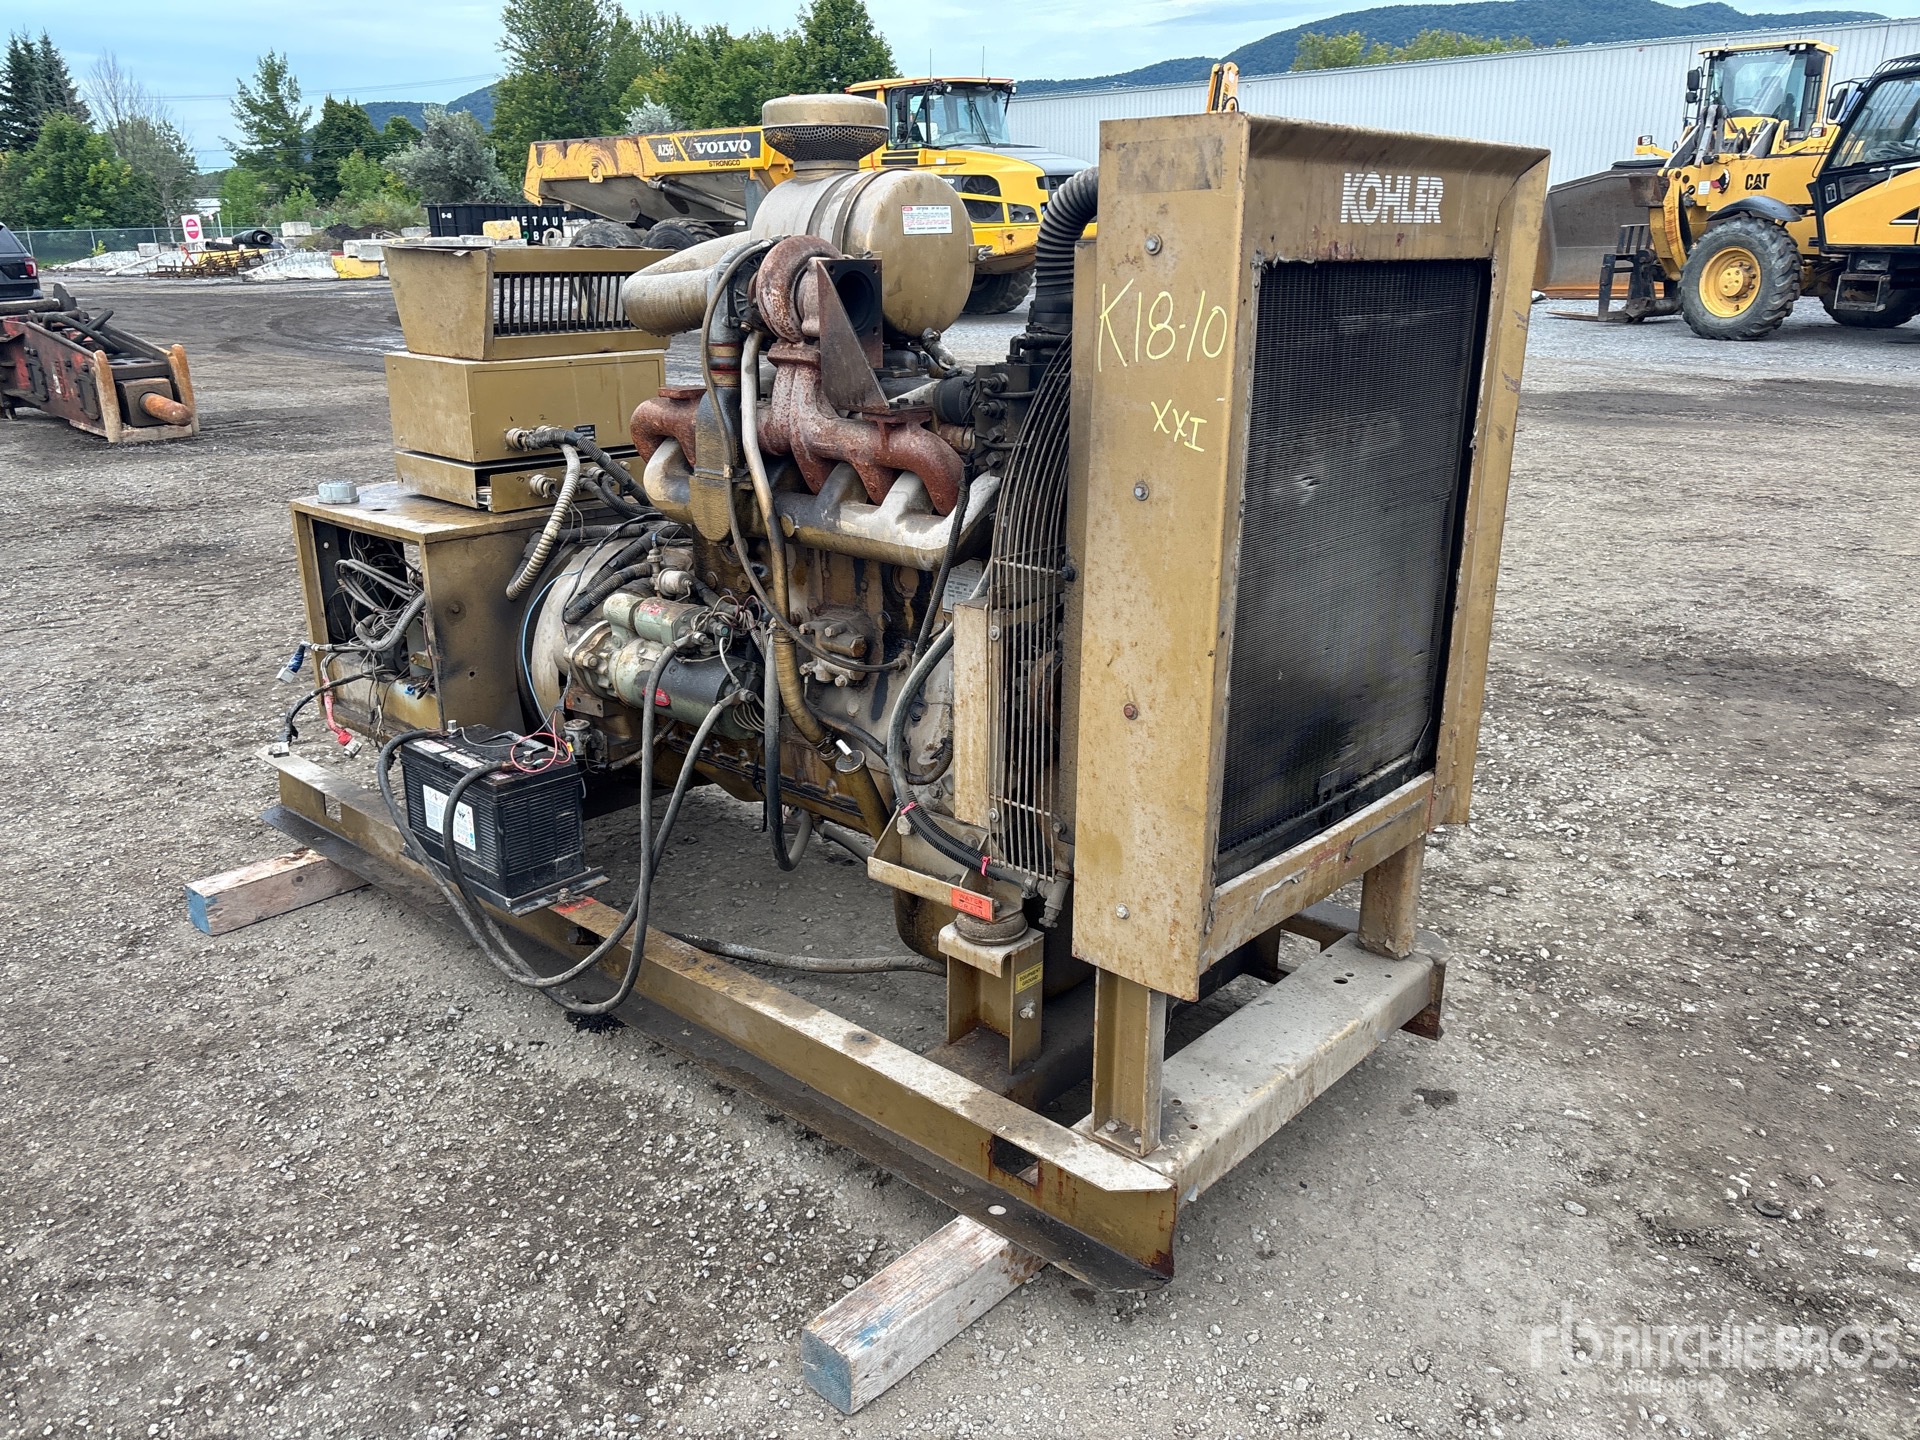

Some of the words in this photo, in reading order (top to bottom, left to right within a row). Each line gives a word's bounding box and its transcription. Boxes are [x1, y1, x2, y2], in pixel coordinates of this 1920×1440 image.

[693, 139, 752, 154] VOLVO
[708, 159, 741, 167] STRONGCO
[1745, 173, 1770, 190] CAT
[1340, 171, 1444, 225] KOHLER
[1098, 278, 1227, 372] K18-10
[959, 892, 983, 907] WATER
[959, 902, 983, 915] DRAIN
[1022, 974, 1039, 986] GROUND
